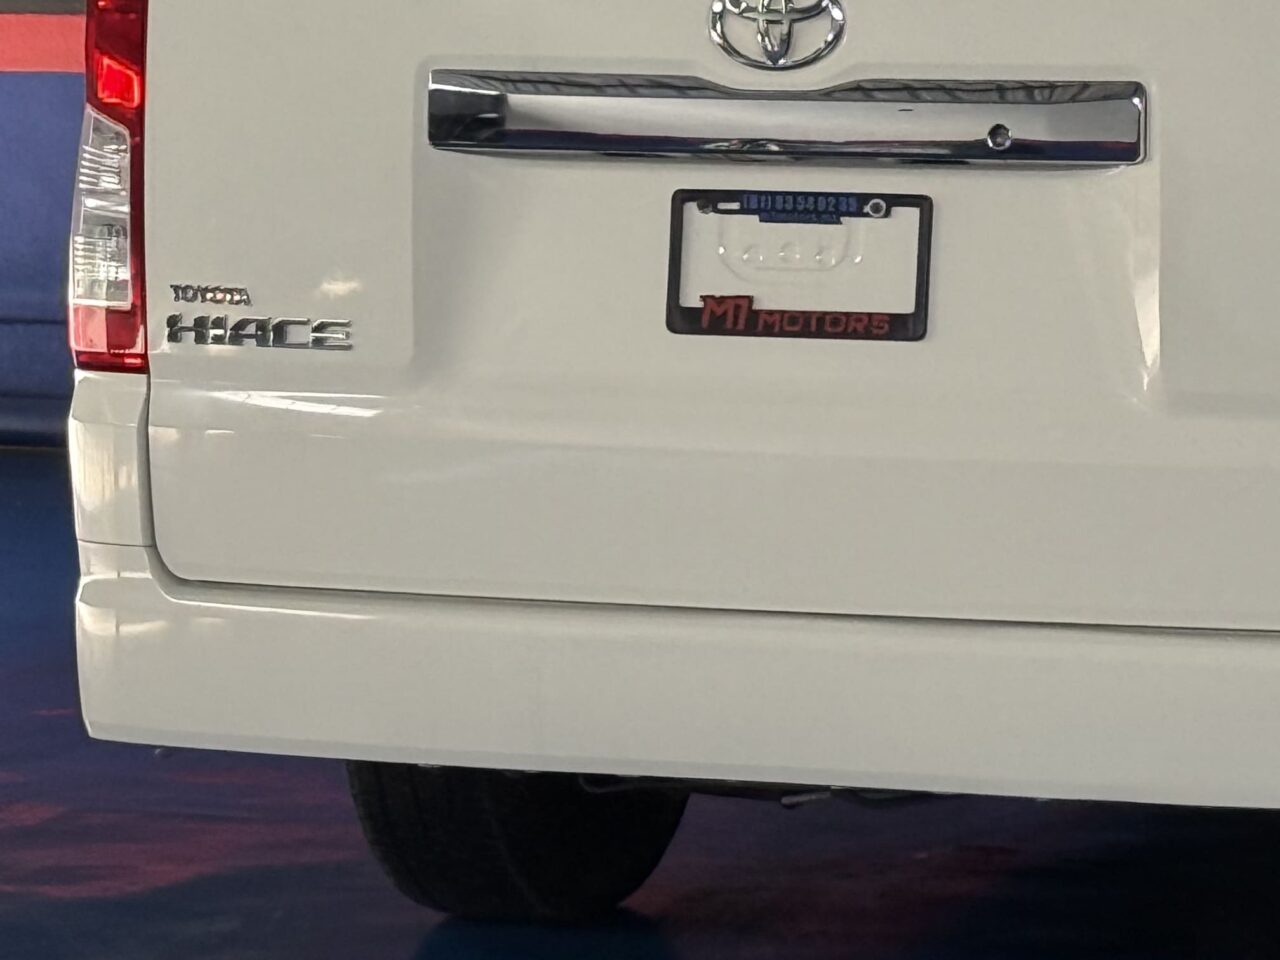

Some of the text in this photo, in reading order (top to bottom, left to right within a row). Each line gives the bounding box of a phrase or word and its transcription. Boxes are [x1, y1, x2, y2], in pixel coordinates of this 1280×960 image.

[170, 285, 252, 306] TOYOTA
[166, 312, 353, 351] HIACE
[757, 310, 891, 334] MOTORS
